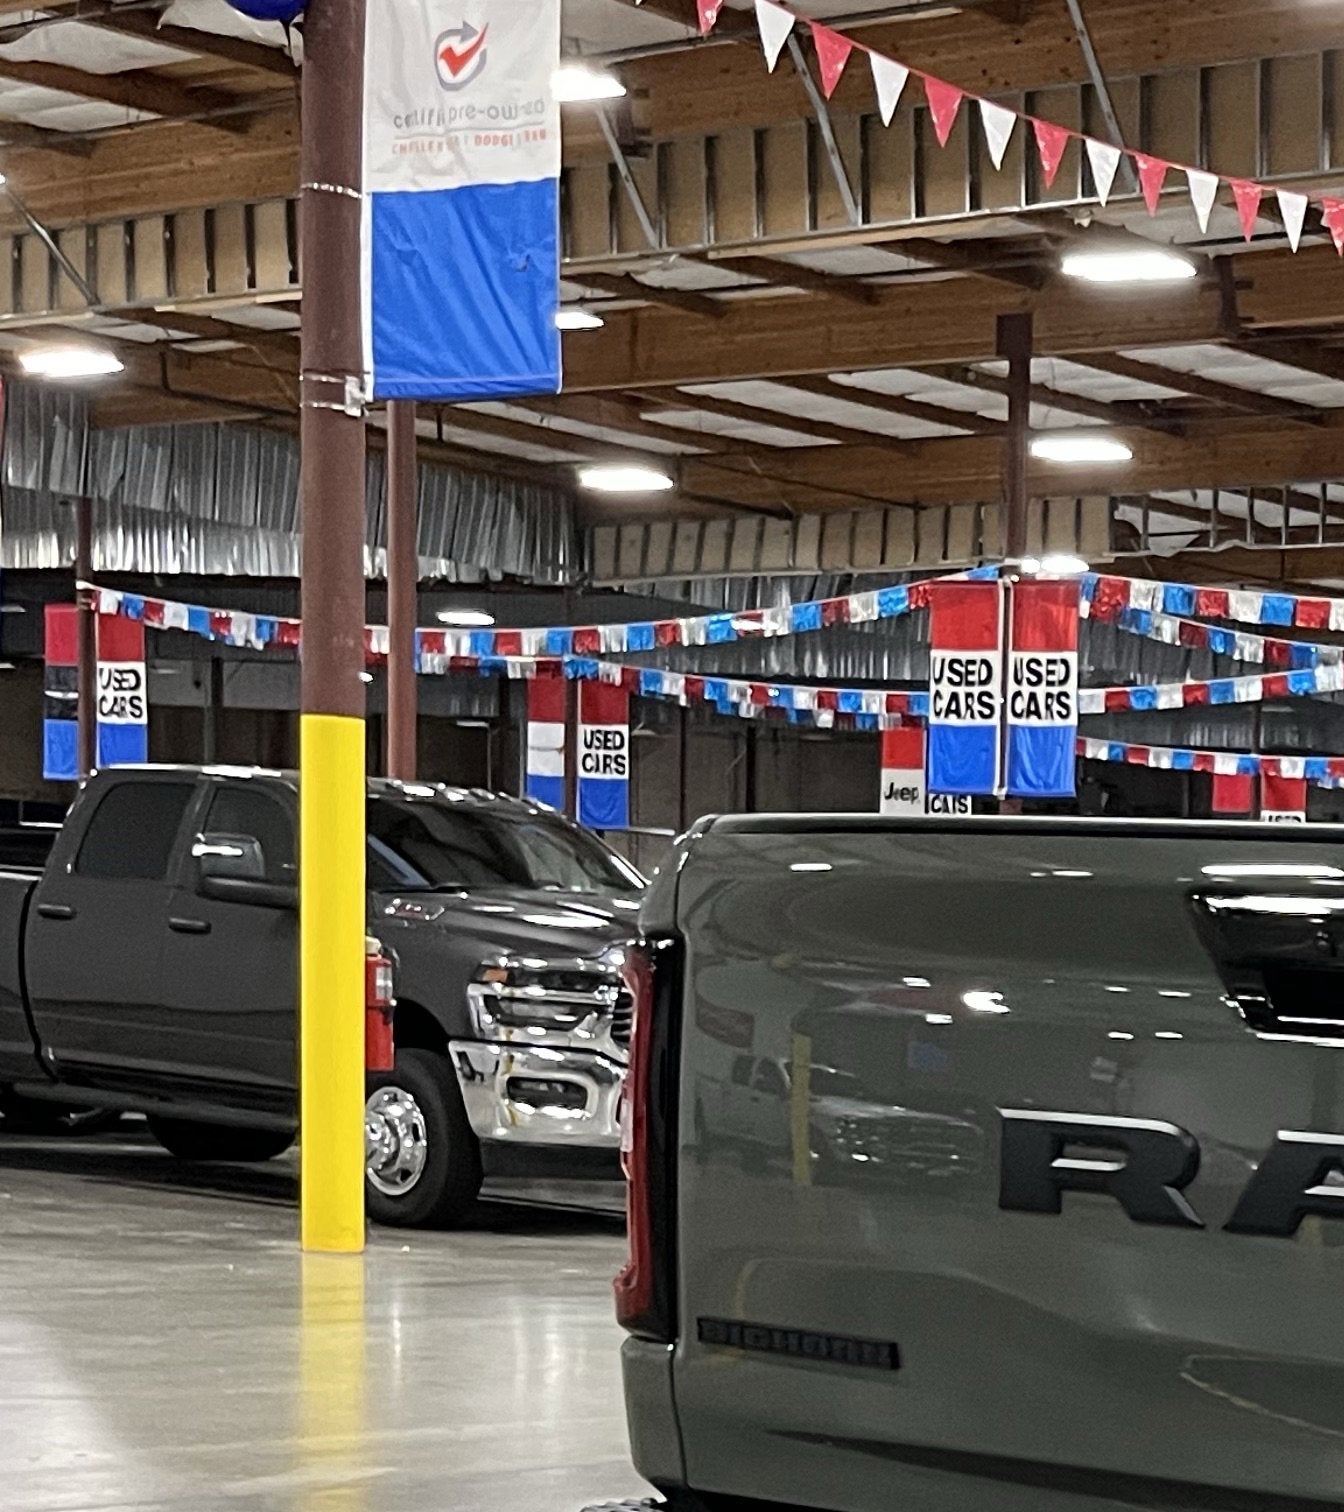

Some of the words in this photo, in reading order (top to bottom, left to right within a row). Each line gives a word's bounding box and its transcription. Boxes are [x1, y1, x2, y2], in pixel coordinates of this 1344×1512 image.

[100, 667, 142, 692] USED
[932, 656, 993, 687] USED
[1013, 657, 1070, 688] USED
[932, 689, 995, 719] CARS
[1011, 690, 1072, 720] CARS
[583, 728, 625, 751] USED
